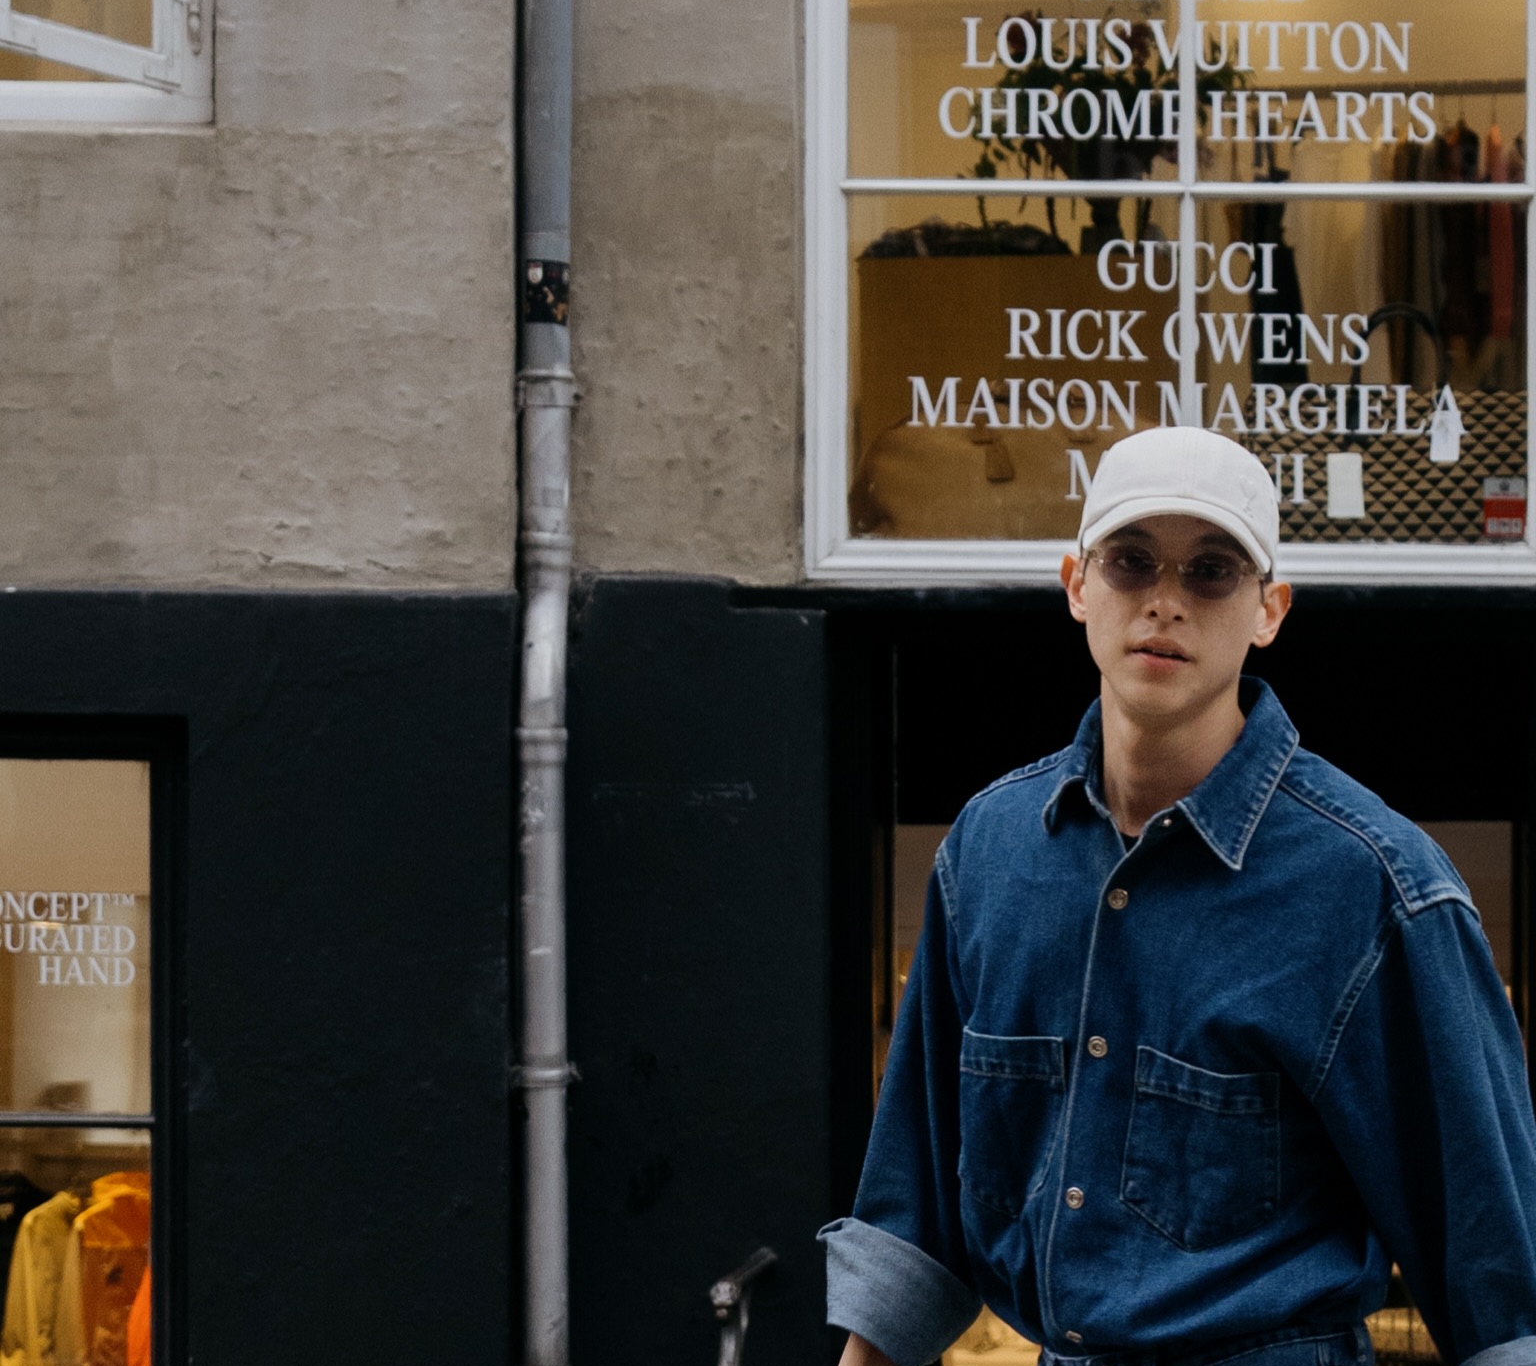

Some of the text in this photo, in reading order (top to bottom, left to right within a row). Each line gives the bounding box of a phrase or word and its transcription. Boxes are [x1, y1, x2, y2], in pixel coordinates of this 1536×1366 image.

[961, 16, 1133, 71] LOUIS
[1207, 90, 1437, 145] HEARTS
[1097, 239, 1278, 294] GUCCI
[1005, 308, 1148, 361] RICK
[908, 376, 1138, 431] MAISON
[0, 923, 136, 954] URATED
[39, 955, 136, 987] HAND
